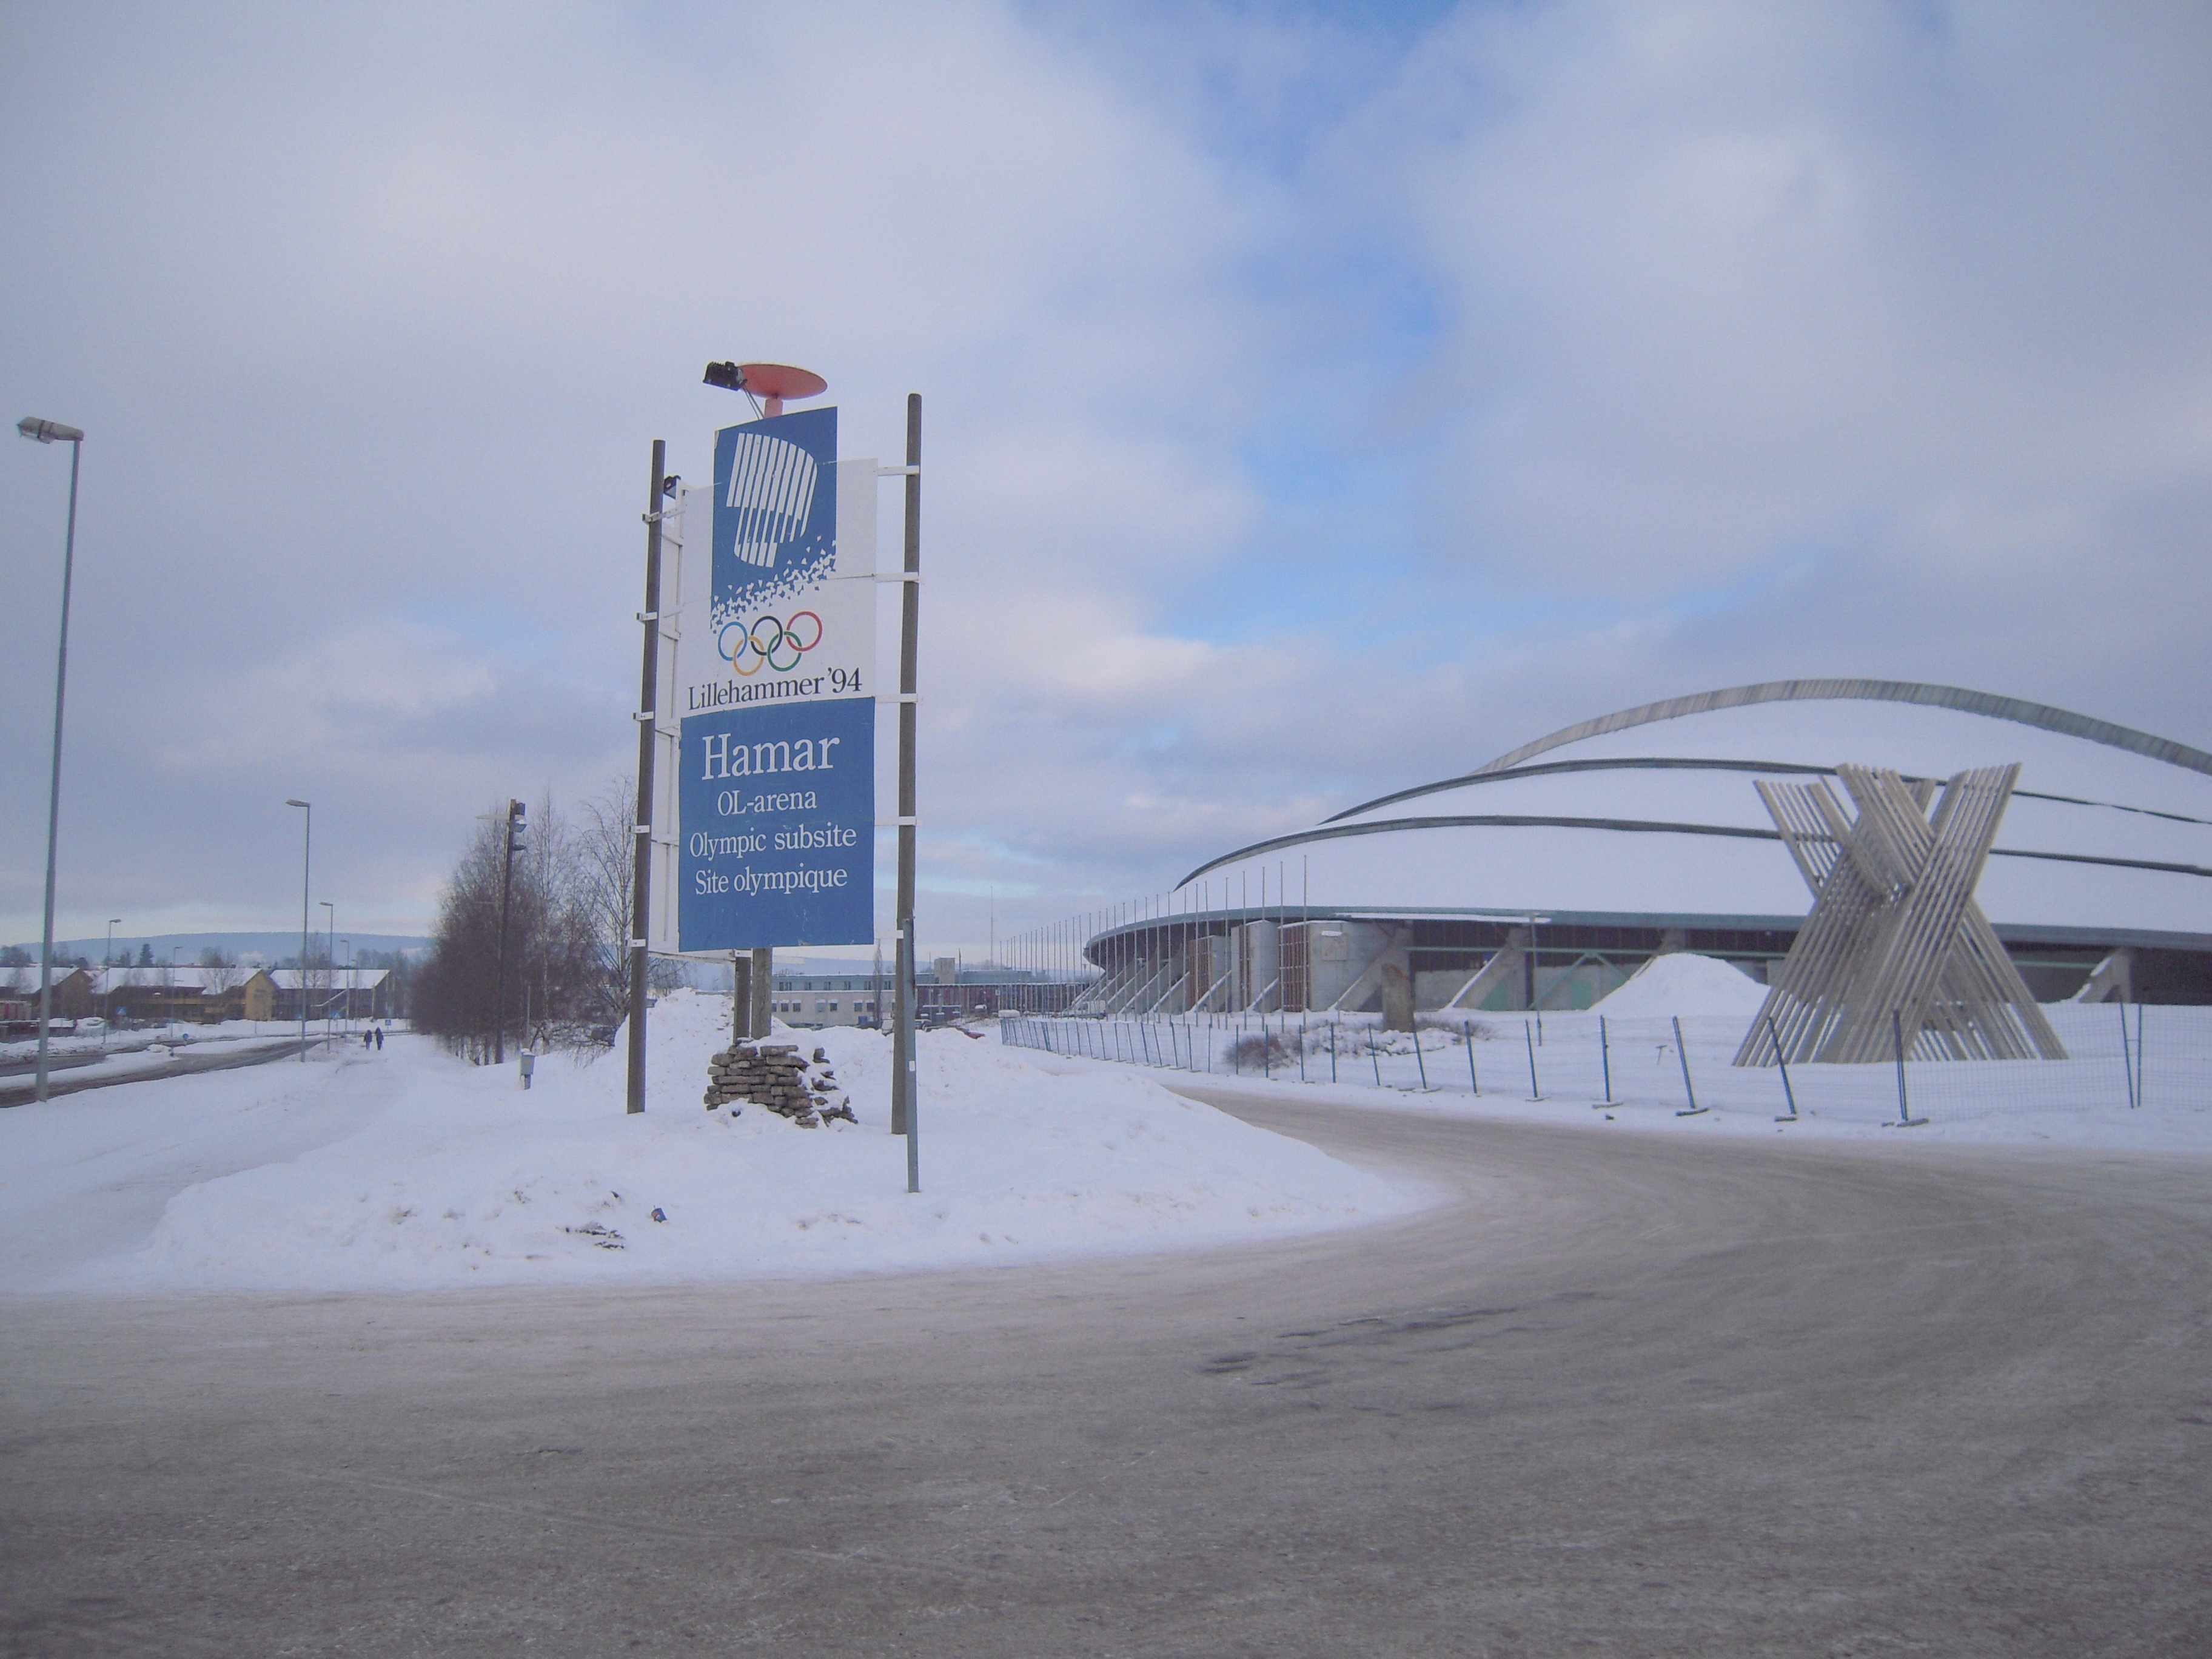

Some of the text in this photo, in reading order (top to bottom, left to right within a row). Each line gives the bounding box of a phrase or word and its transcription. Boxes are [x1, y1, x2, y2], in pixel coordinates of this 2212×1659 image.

[688, 667, 862, 710] Lillehammer '94
[702, 732, 840, 780] Hamar
[717, 789, 817, 816] OL-arena
[689, 822, 857, 861] Olympic subsite
[694, 862, 848, 897] Site olympique
